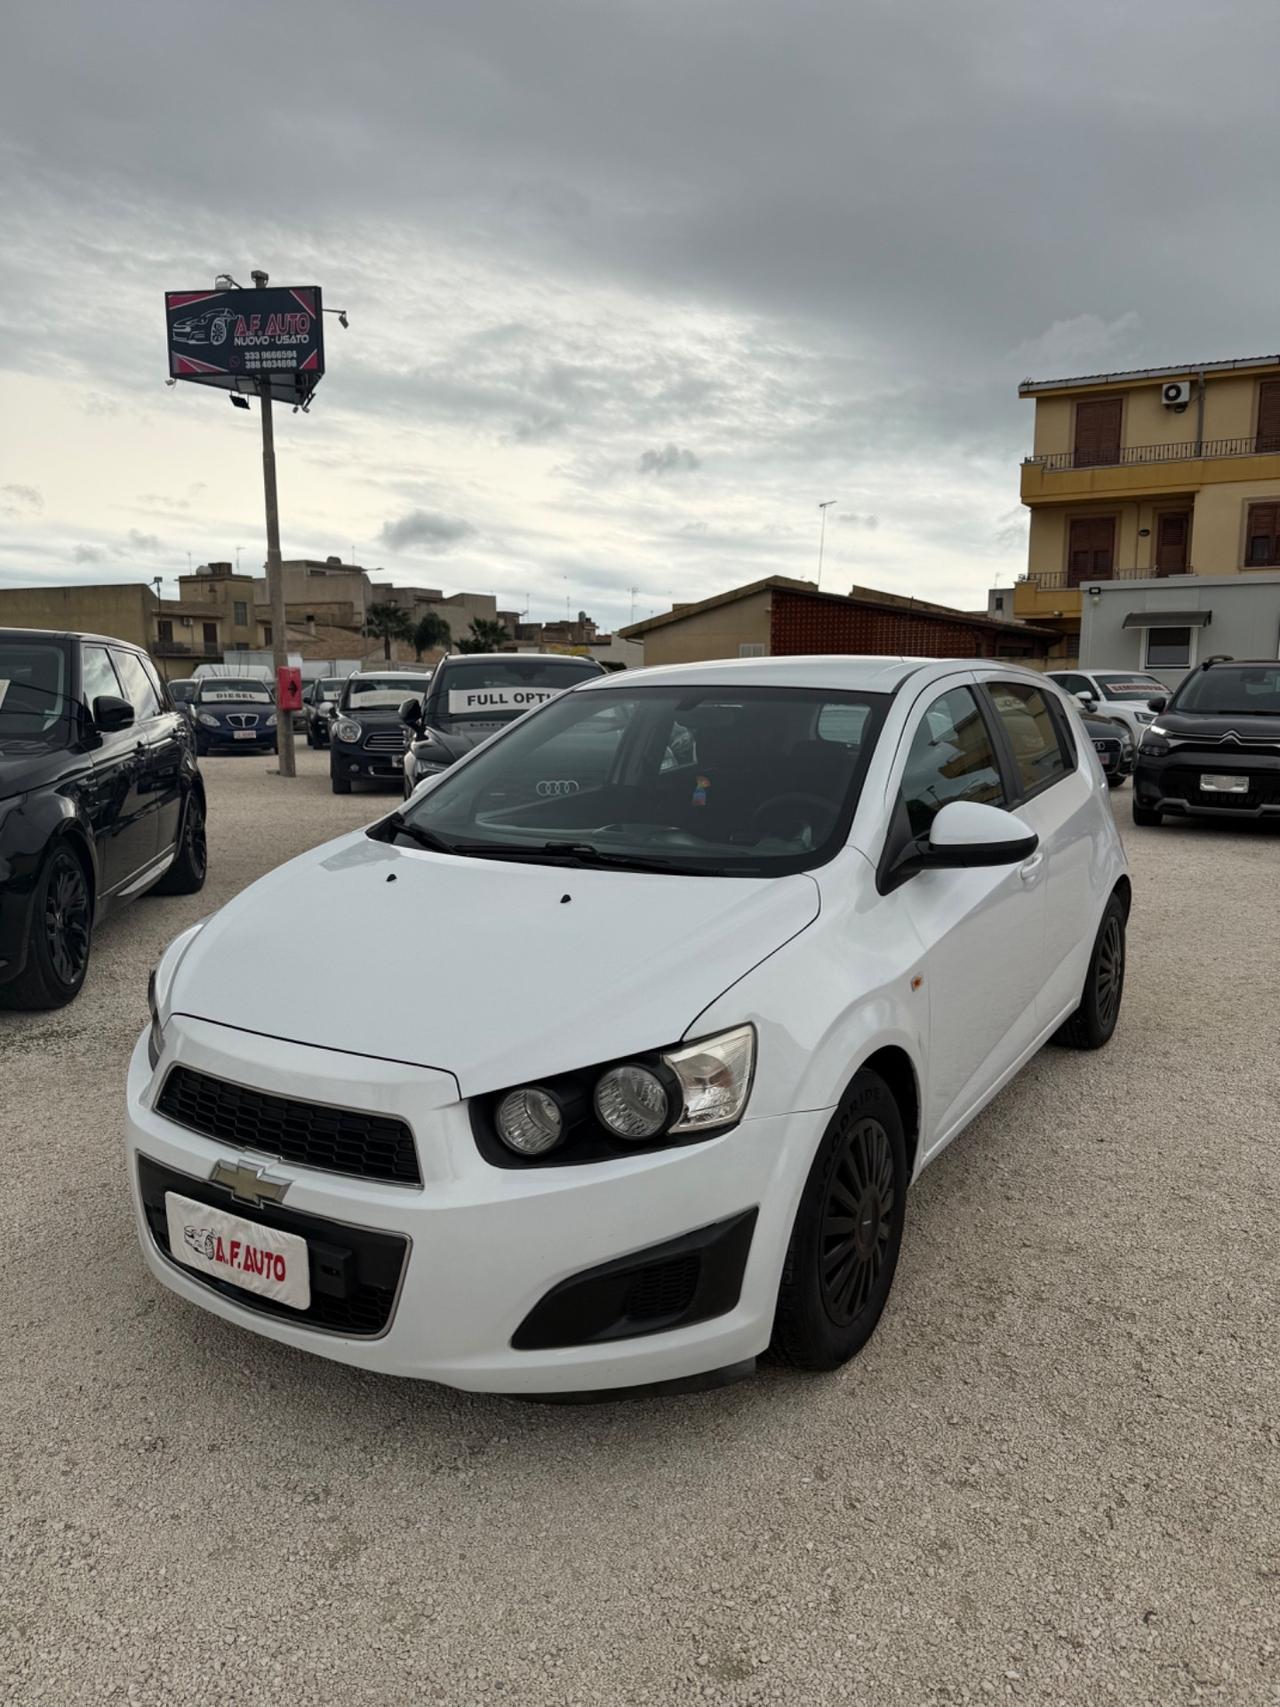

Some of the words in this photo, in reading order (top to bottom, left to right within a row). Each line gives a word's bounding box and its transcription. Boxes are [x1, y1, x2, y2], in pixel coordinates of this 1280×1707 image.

[234, 314, 263, 337] A.F.
[265, 312, 310, 336] AUTO
[216, 692, 255, 700] DIESEL
[467, 693, 509, 706] FULL
[215, 1236, 242, 1270] A.F.
[243, 1244, 287, 1282] AUTO
